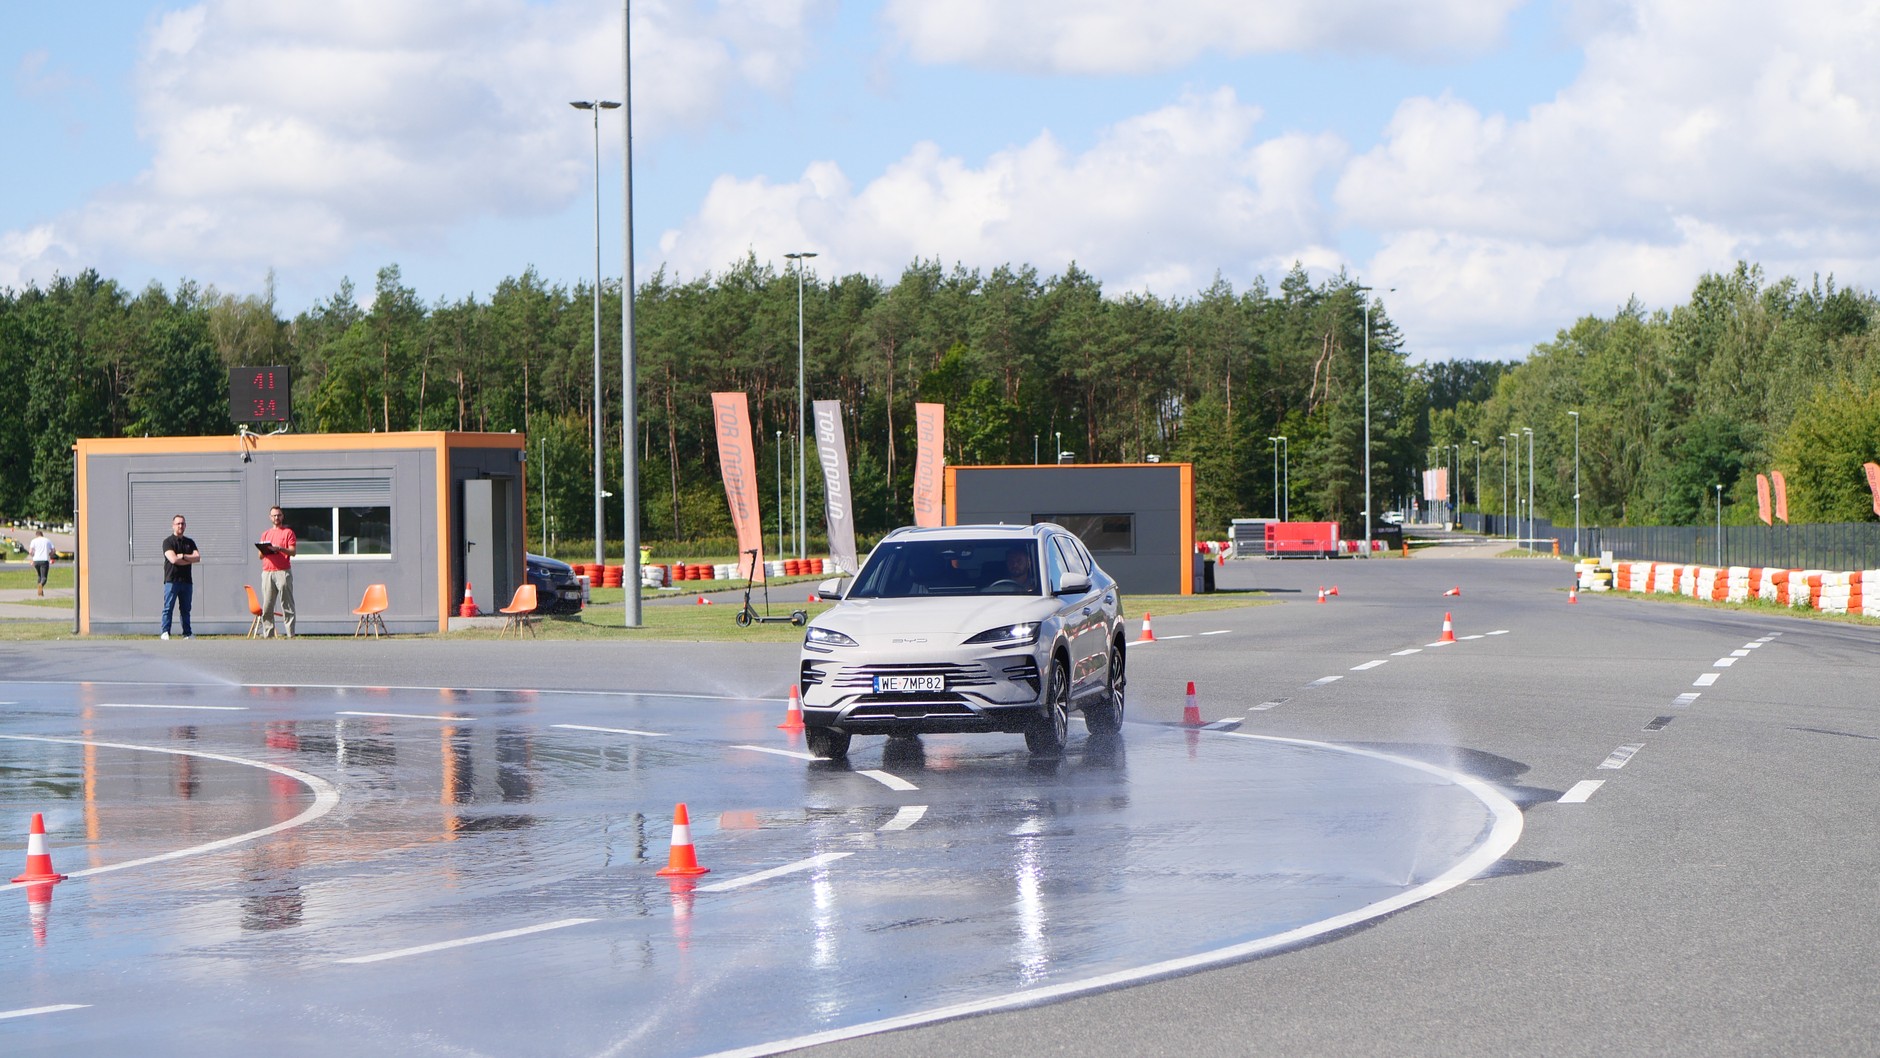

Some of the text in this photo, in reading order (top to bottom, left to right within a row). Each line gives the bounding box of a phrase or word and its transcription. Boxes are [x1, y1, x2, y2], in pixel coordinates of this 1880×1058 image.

[719, 403, 739, 439] TOR
[818, 410, 844, 520] TOR MODLIN
[917, 412, 934, 514] TOR MODLIN
[881, 677, 941, 690] WE 7MP82
